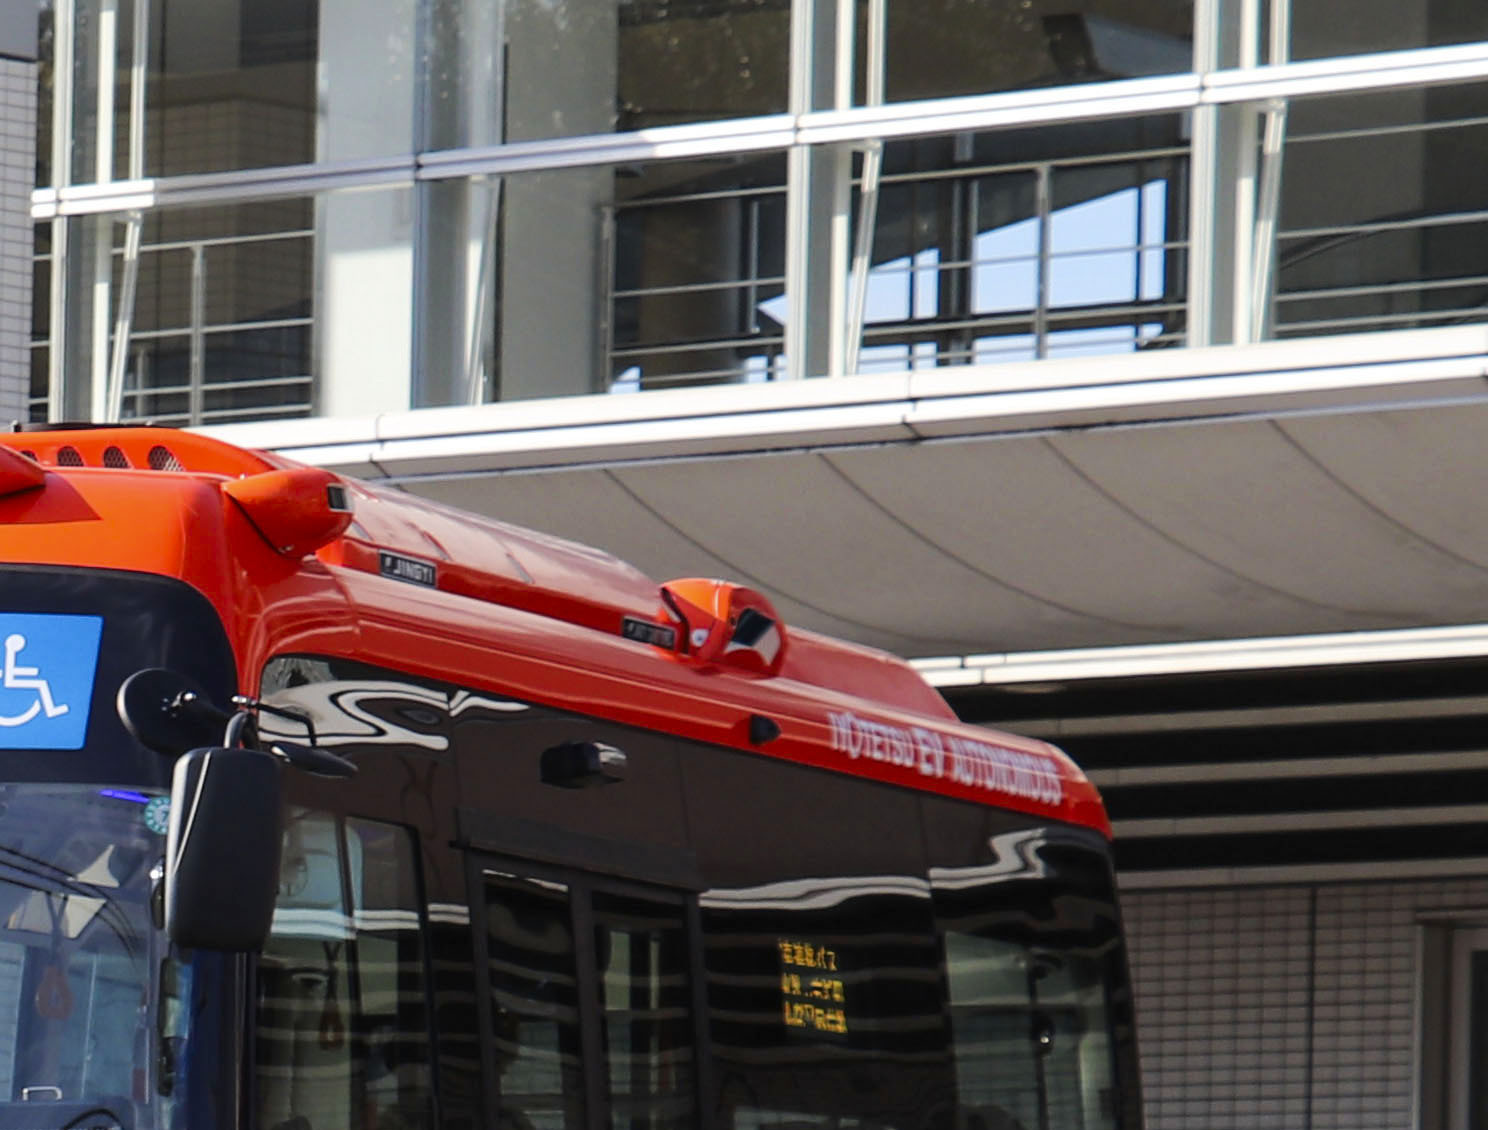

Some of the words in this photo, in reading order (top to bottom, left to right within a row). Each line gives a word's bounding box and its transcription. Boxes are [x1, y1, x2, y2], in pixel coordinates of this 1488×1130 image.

[828, 711, 914, 768] IYOTETSU
[912, 727, 945, 778] EV
[947, 735, 1062, 806] AUTONOMOUS
